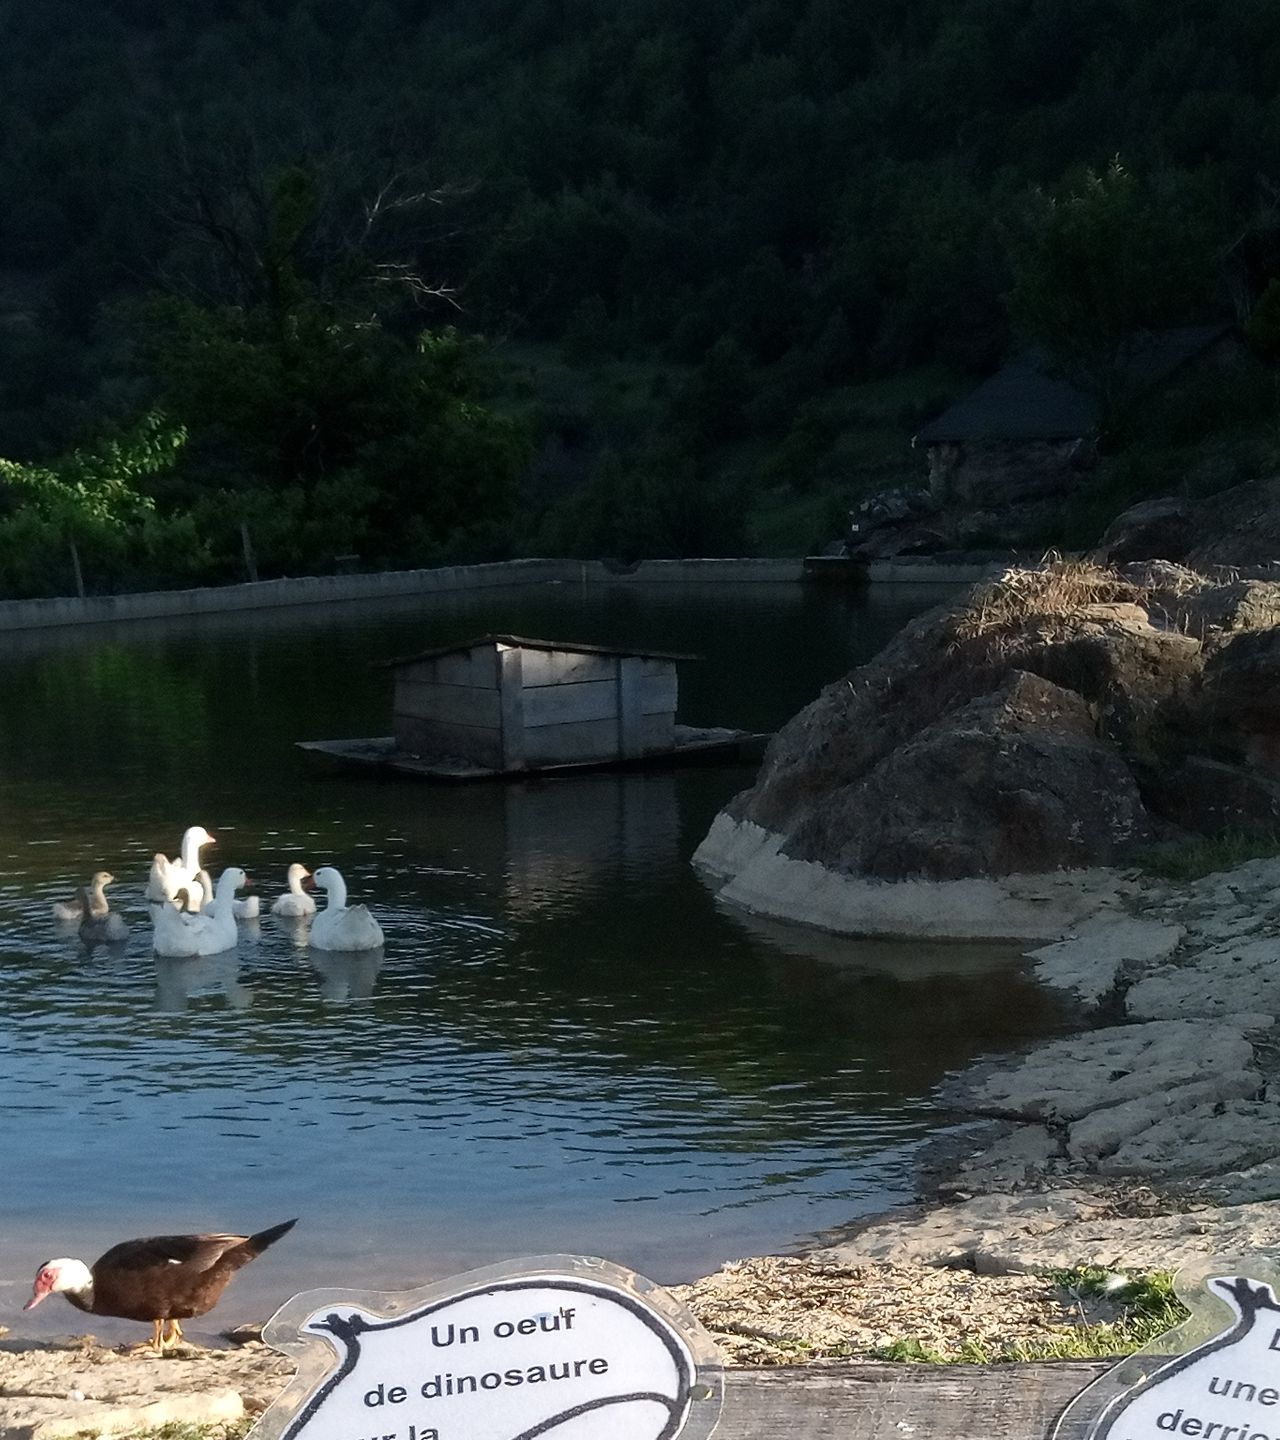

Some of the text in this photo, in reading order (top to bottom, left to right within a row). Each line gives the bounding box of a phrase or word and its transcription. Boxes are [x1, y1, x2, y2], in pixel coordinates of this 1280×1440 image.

[431, 1307, 577, 1348] Un oeuf
[364, 1355, 609, 1407] de dinosaure
[1209, 1376, 1280, 1406] une
